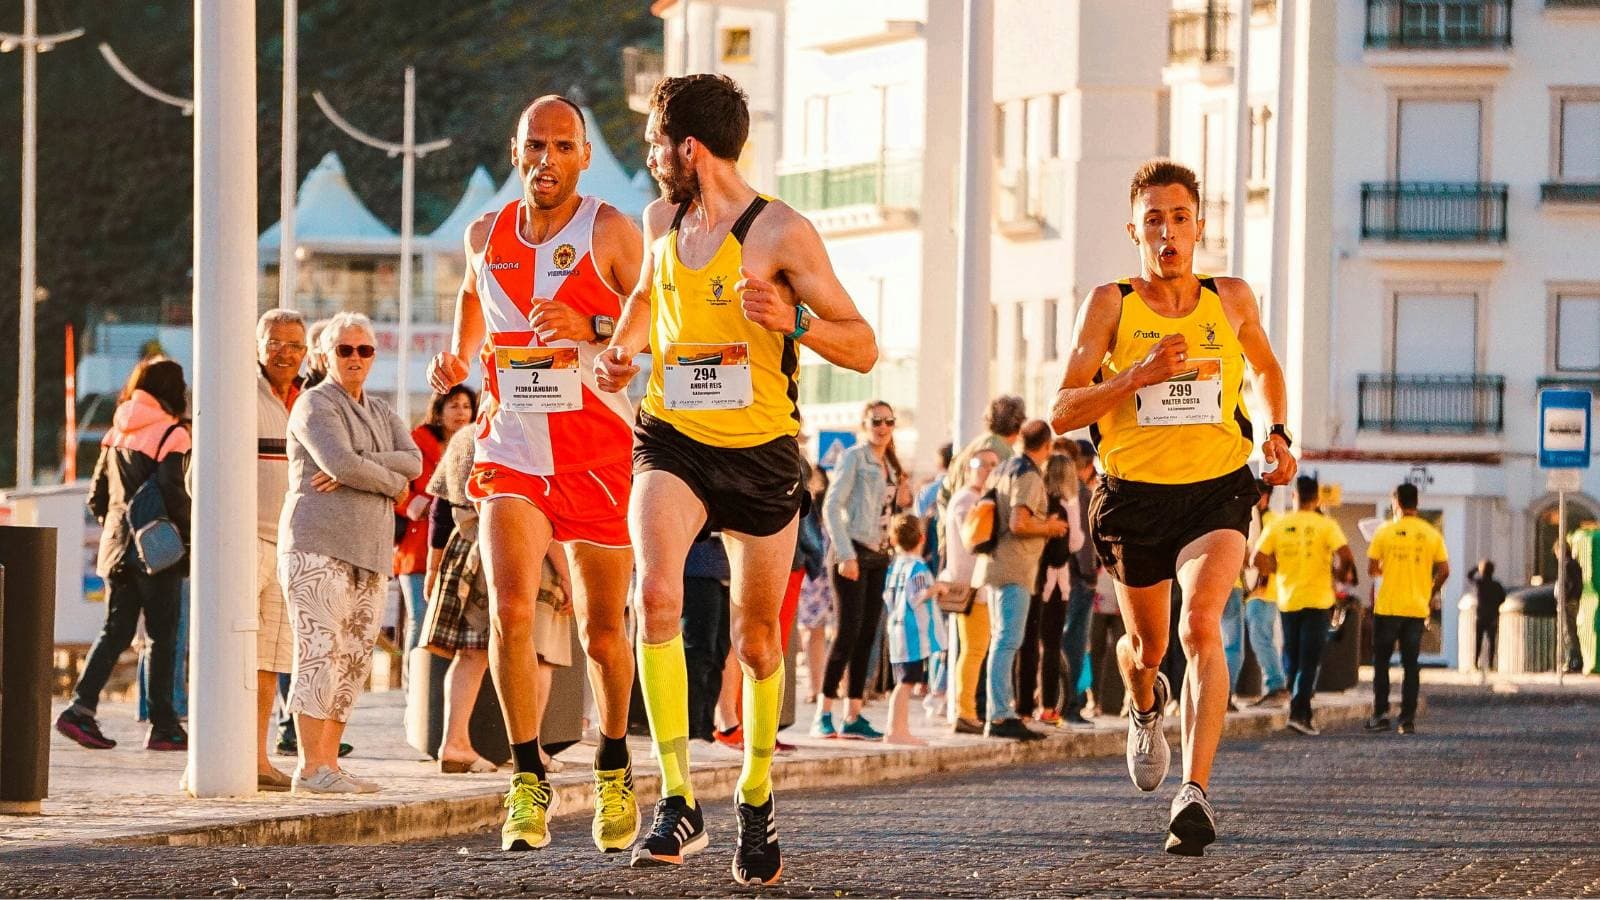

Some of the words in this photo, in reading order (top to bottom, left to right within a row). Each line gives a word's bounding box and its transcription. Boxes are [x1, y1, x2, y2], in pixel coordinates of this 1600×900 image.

[531, 371, 539, 384] 2
[693, 367, 717, 381] 294
[1169, 383, 1192, 397] 299
[1161, 398, 1182, 406] VALTER
[1182, 397, 1200, 405] COSTA
